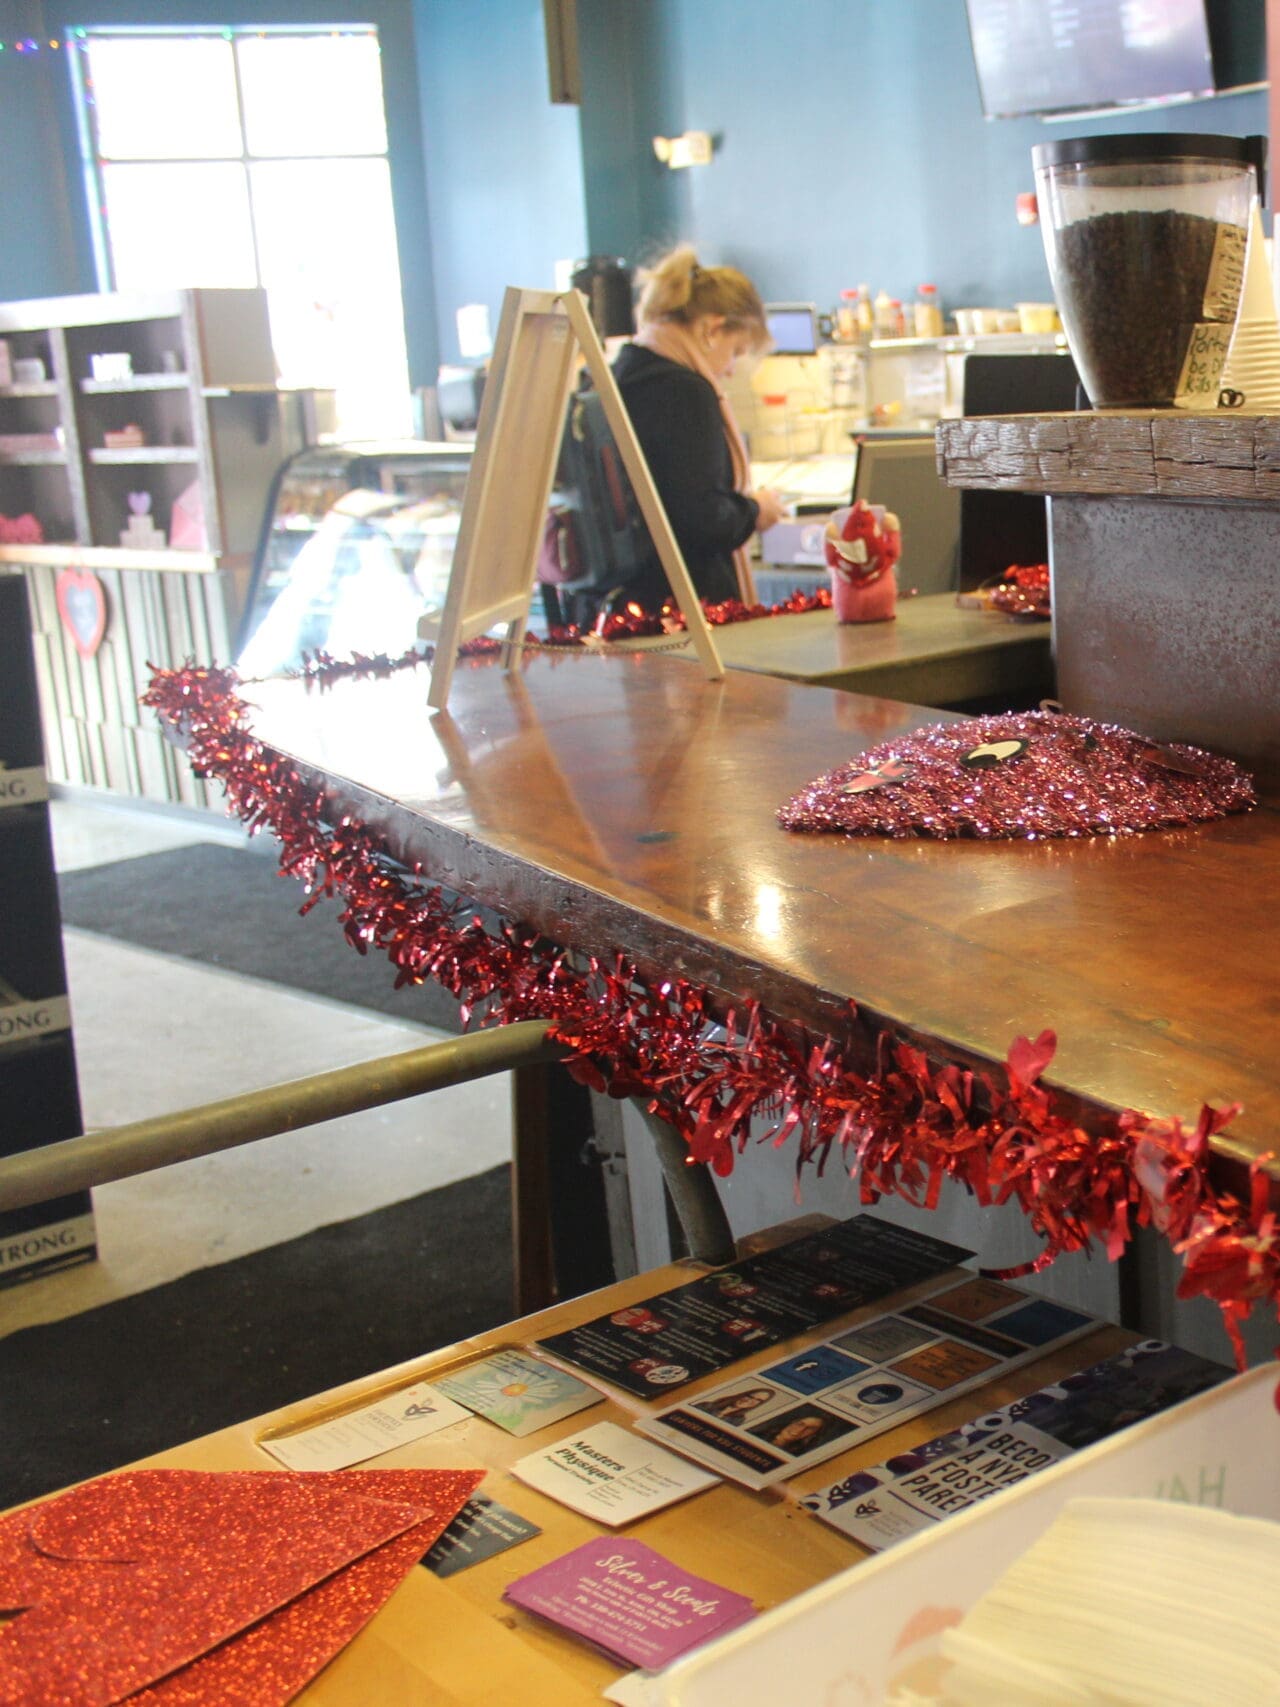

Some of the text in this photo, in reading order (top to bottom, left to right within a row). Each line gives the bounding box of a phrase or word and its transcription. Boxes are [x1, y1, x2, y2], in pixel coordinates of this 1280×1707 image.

[556, 1448, 616, 1482] Physique
[571, 1441, 626, 1472] Masters
[959, 1450, 986, 1465] A
[595, 1555, 646, 1584] Silver
[663, 1586, 720, 1616] Scents
